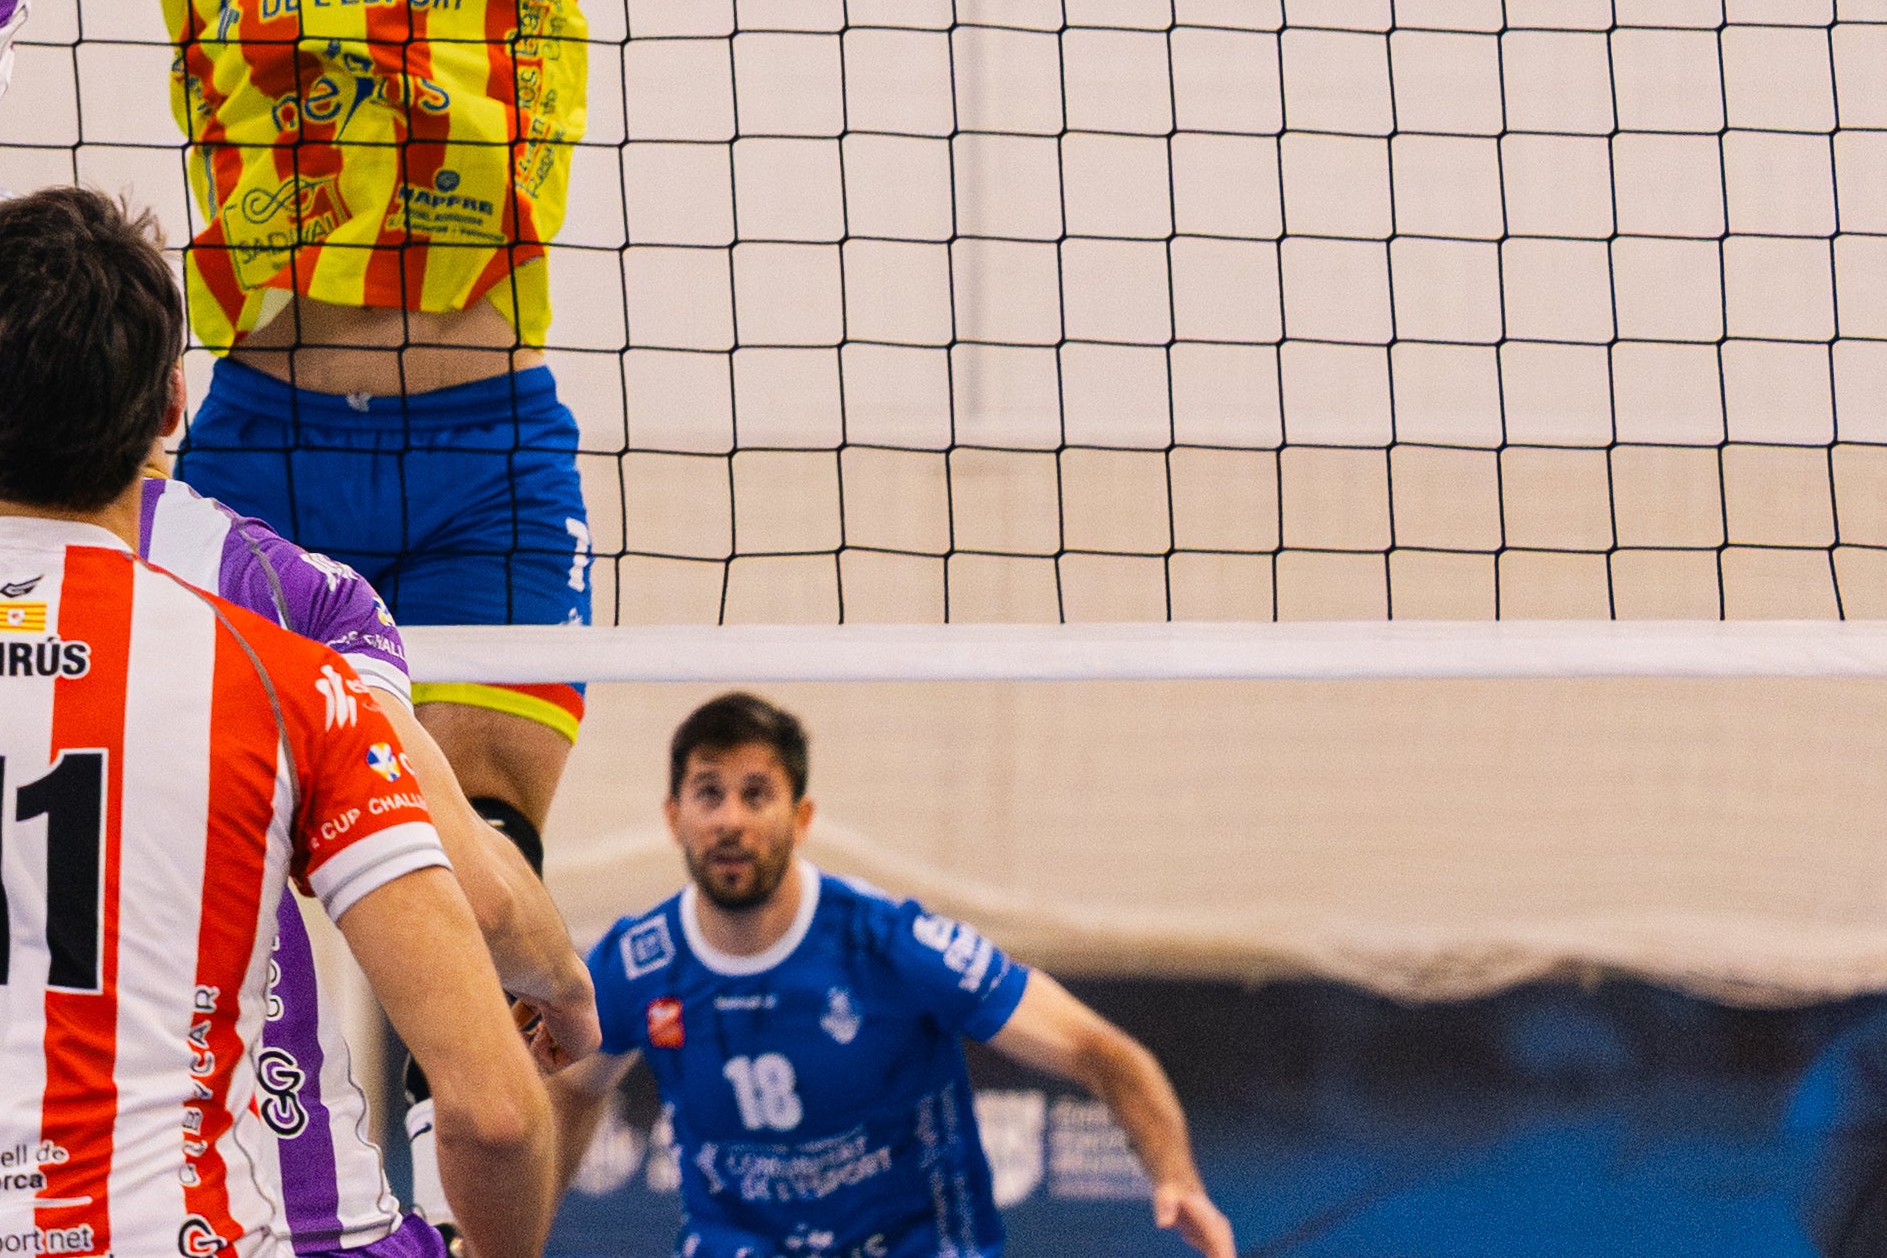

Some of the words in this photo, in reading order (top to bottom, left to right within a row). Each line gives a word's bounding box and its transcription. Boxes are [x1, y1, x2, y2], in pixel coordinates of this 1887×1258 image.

[320, 807, 361, 841] CUP
[723, 1053, 804, 1132] 18
[36, 1142, 67, 1162] de
[49, 1226, 92, 1250] net
